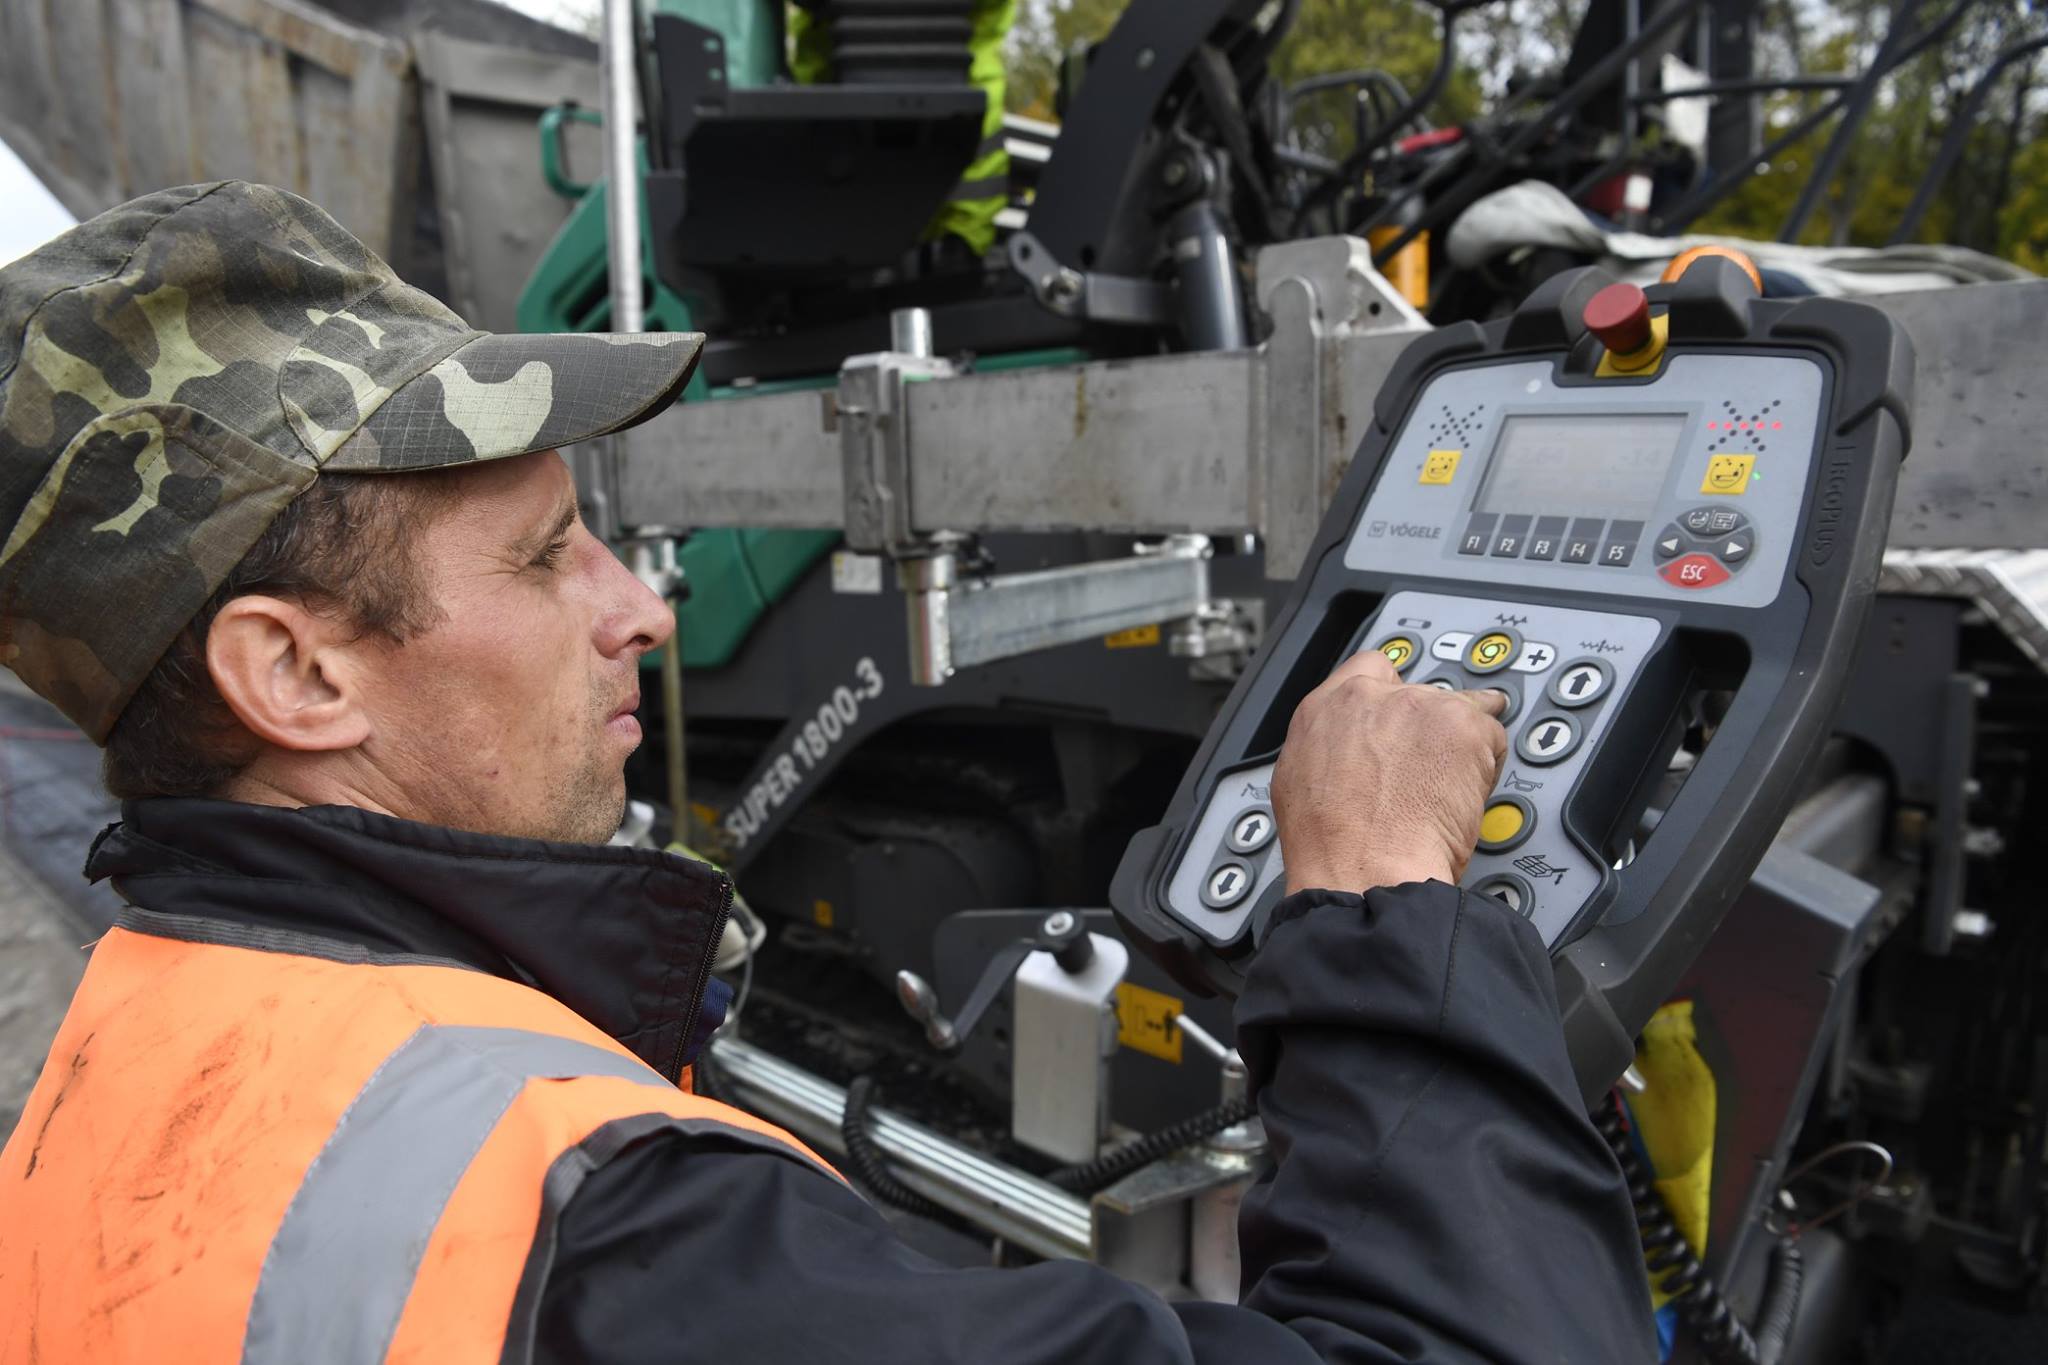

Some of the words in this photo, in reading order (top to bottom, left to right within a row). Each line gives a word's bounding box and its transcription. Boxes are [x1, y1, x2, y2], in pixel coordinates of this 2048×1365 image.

[1389, 522, 1442, 539] VÖGELE
[1466, 536, 1480, 549] F1
[1500, 538, 1515, 552] F2
[1534, 540, 1550, 554] F3
[1570, 543, 1587, 557] F4
[1608, 545, 1625, 560] F5
[1680, 564, 1706, 581] ESC
[725, 754, 801, 848] SUPER
[792, 656, 884, 770] 1800-3
